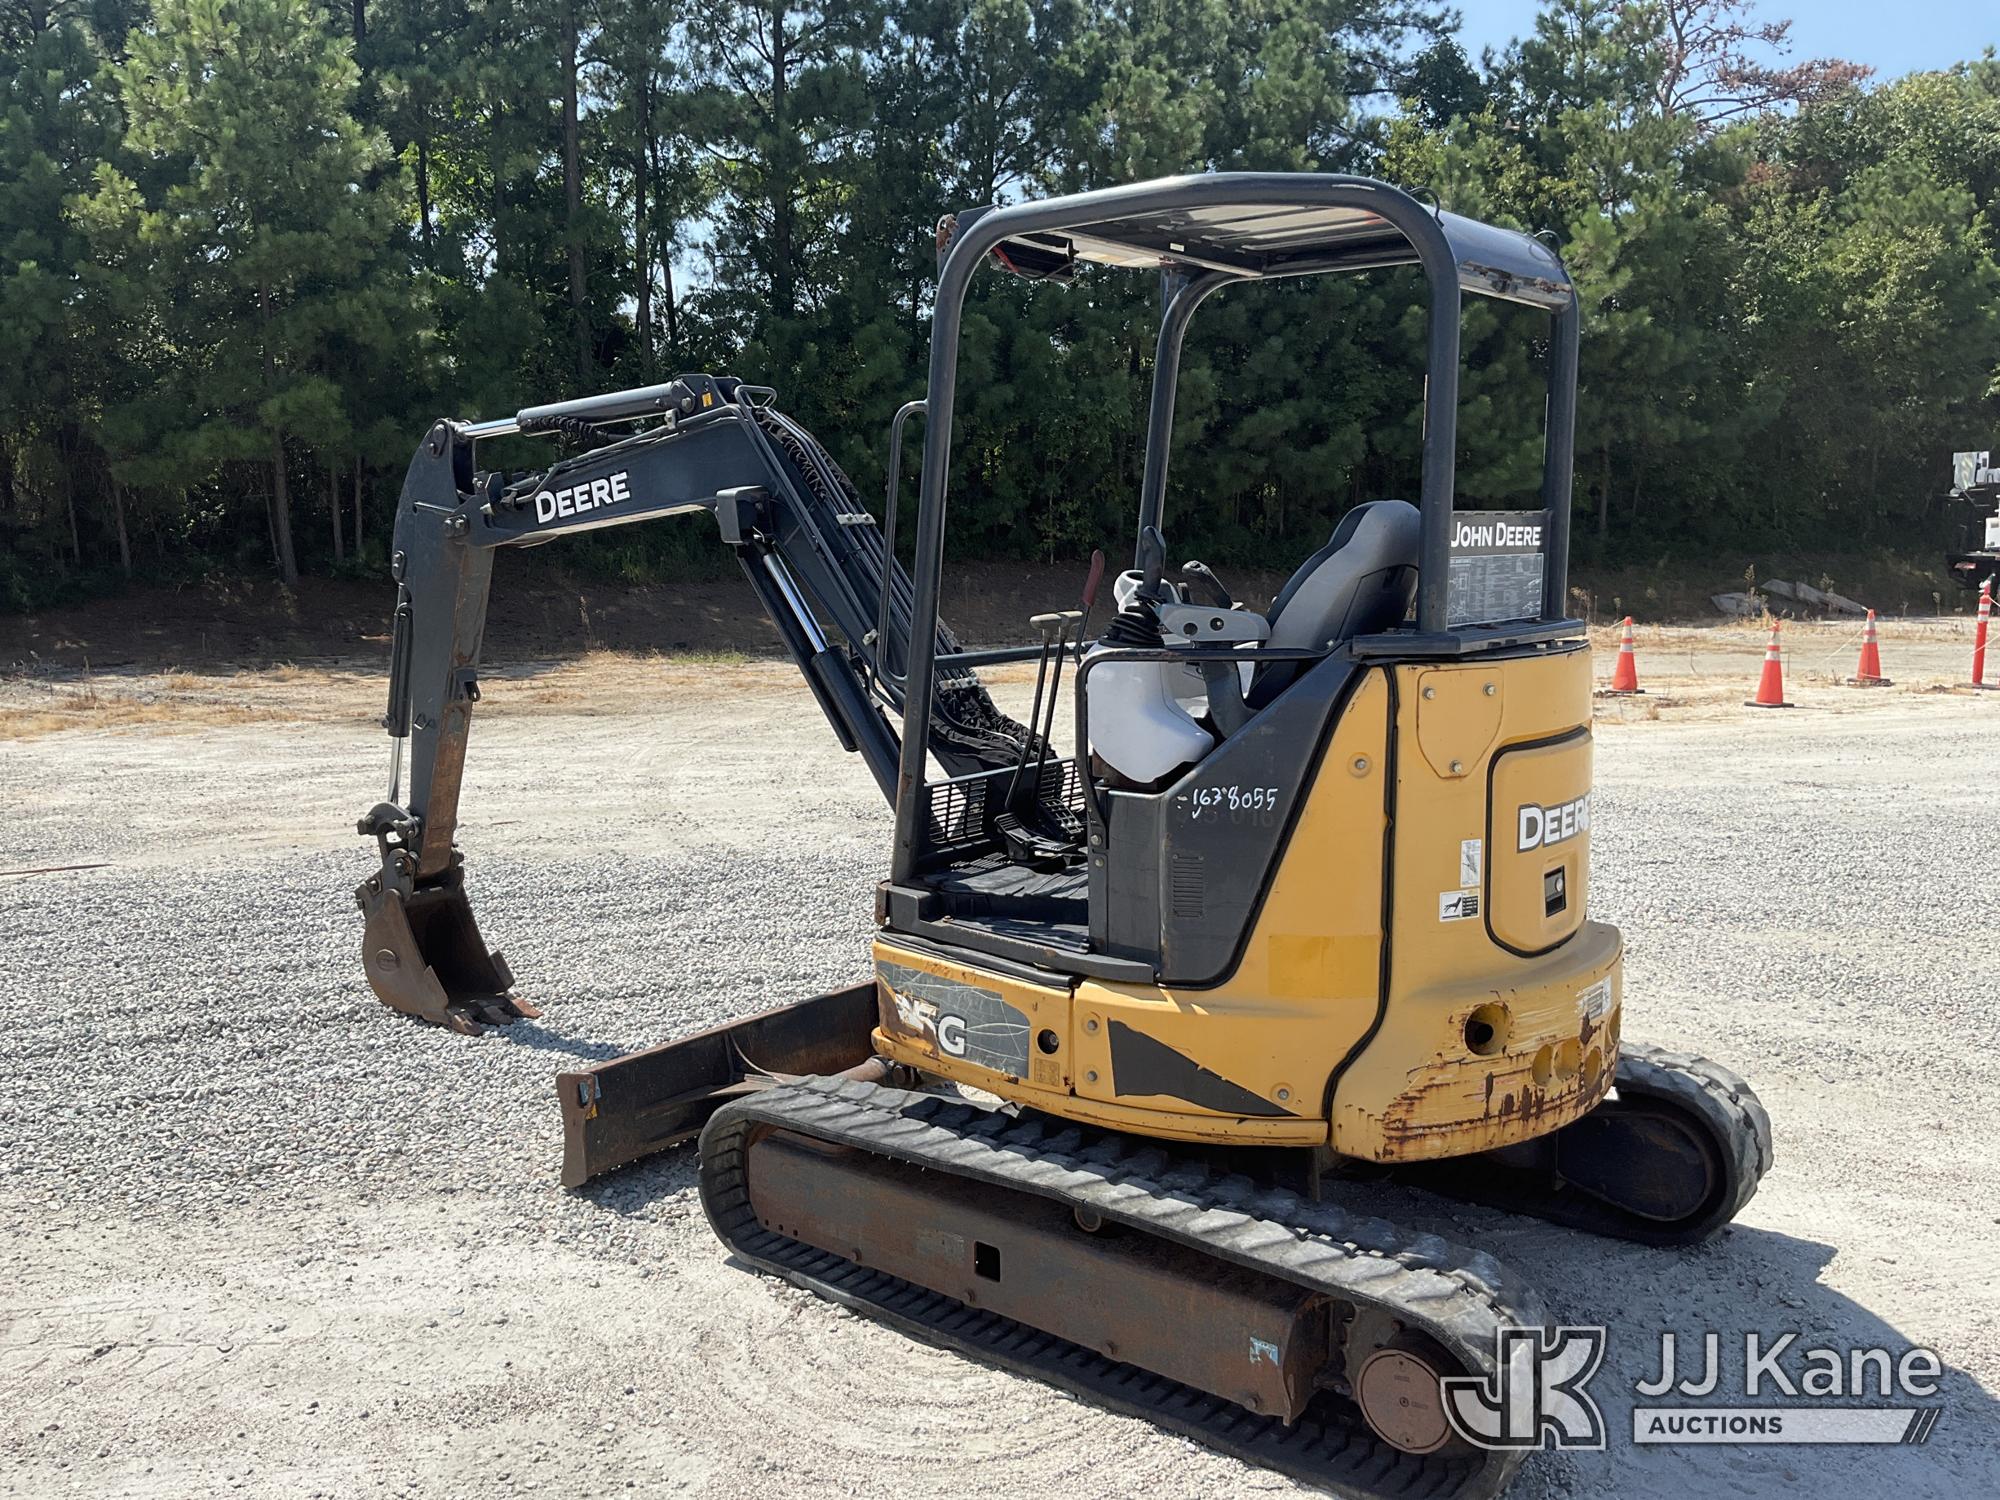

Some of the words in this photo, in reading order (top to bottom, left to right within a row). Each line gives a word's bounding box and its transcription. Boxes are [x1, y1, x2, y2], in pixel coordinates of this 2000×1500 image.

[535, 471, 631, 524] DEERE
[1450, 521, 1493, 548] JOHN
[1495, 521, 1542, 547] DEERE
